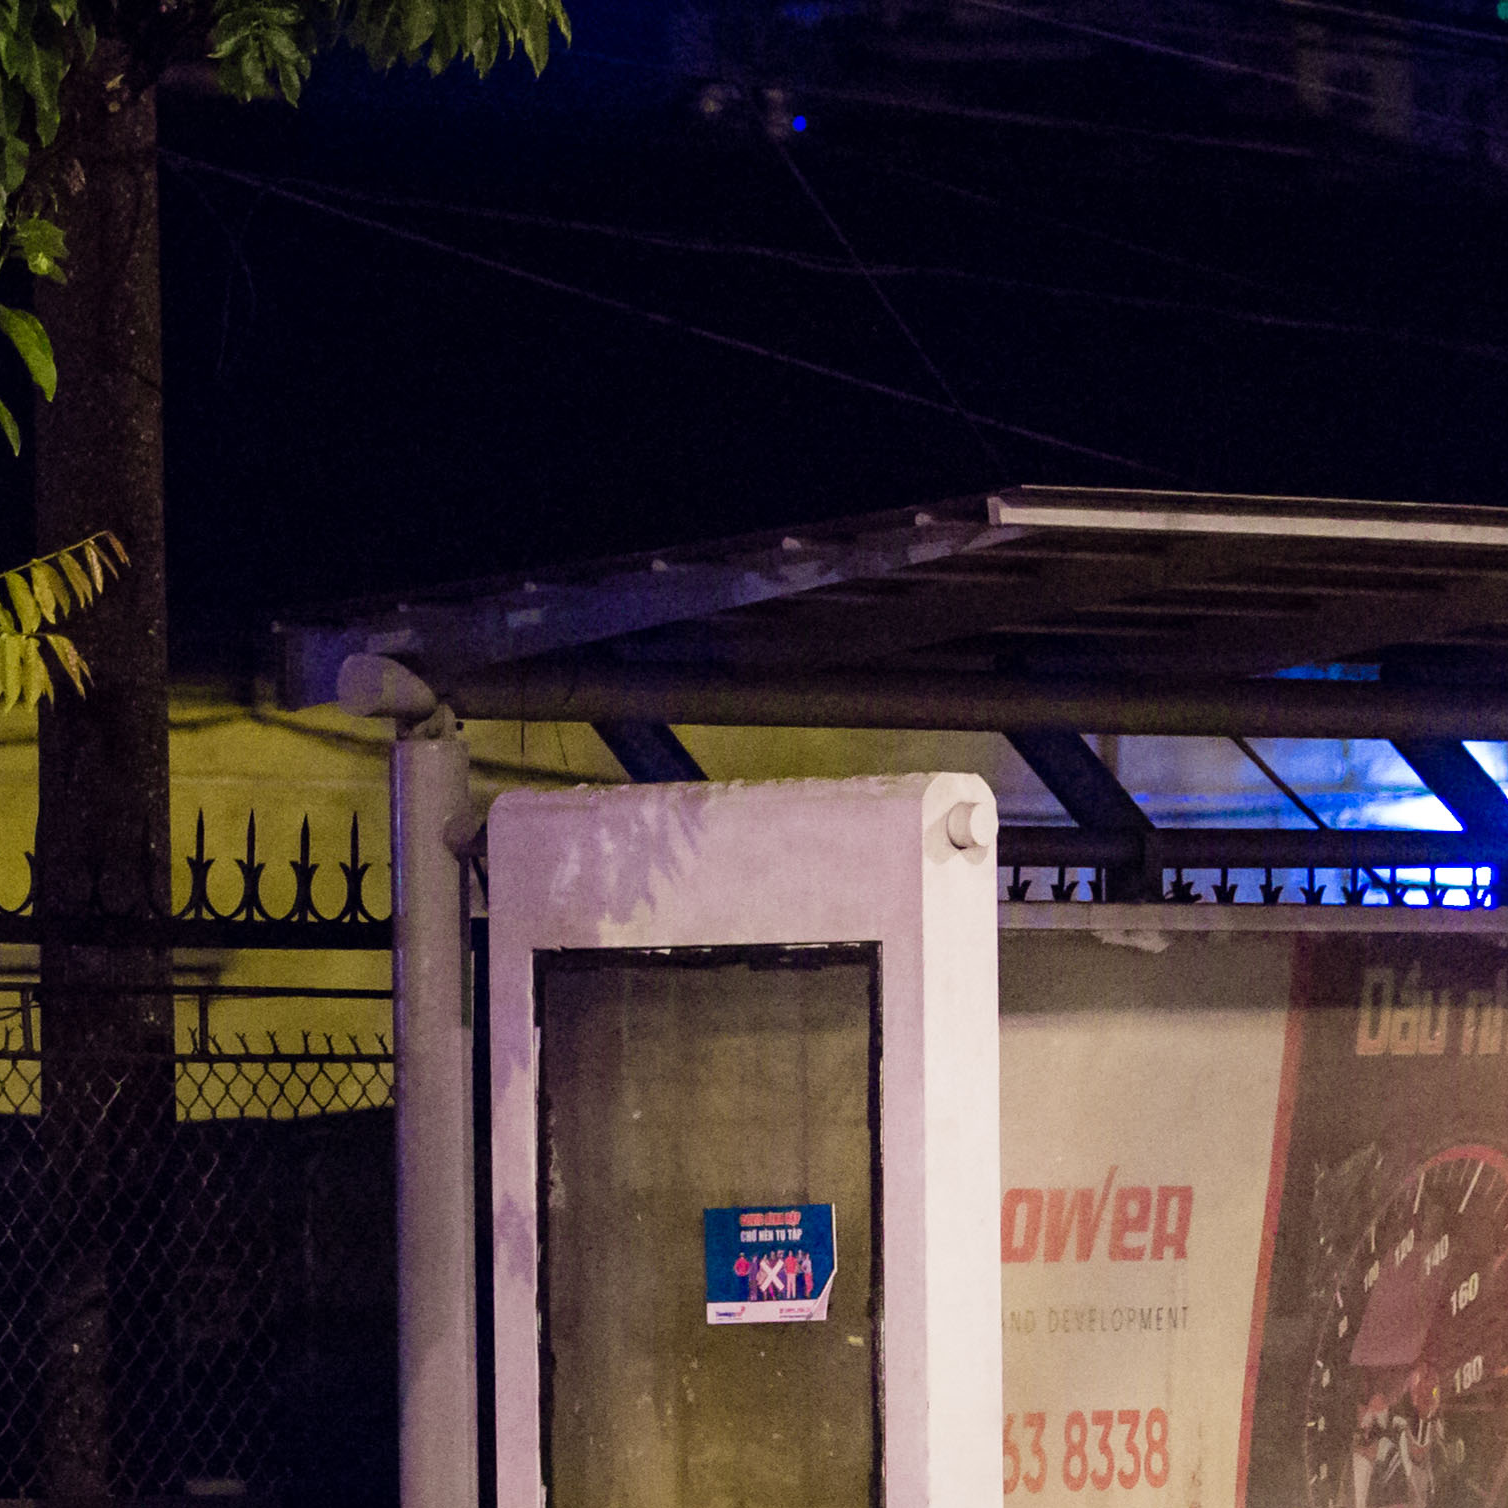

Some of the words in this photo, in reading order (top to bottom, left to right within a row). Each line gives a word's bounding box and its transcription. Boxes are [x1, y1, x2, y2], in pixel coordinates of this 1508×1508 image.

[1450, 1272, 1480, 1316] 160
[1048, 1306, 1189, 1333] DEVELOPMENT
[1454, 1355, 1483, 1393] 180
[1062, 1407, 1171, 1491] 8338
